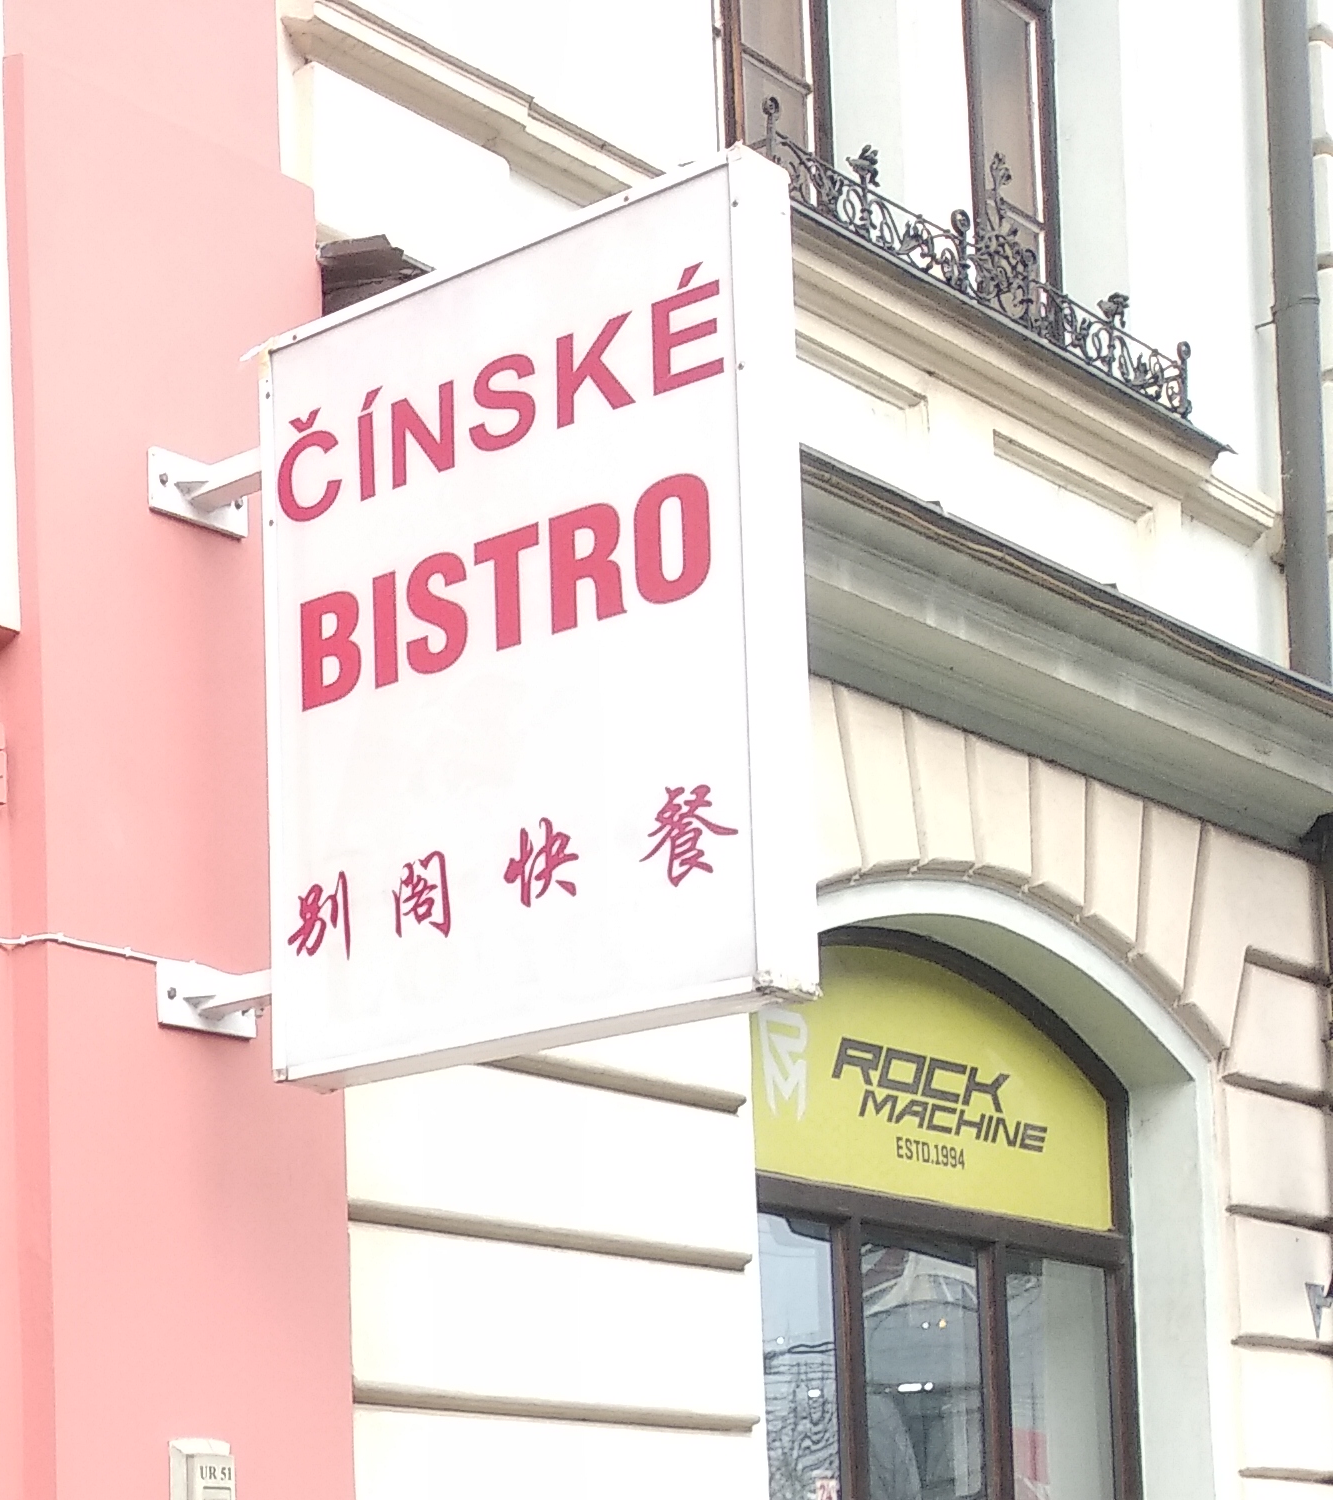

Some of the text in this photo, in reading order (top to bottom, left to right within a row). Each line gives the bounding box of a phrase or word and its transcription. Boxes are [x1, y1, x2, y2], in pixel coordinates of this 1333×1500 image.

[276, 261, 725, 523] ČÍNSKÉ
[299, 473, 712, 712] BISTRO
[831, 1036, 1010, 1113] ROCK
[858, 1089, 1048, 1153] MACHINE
[895, 1136, 965, 1170] ESTD.1994
[199, 1465, 218, 1481] UR
